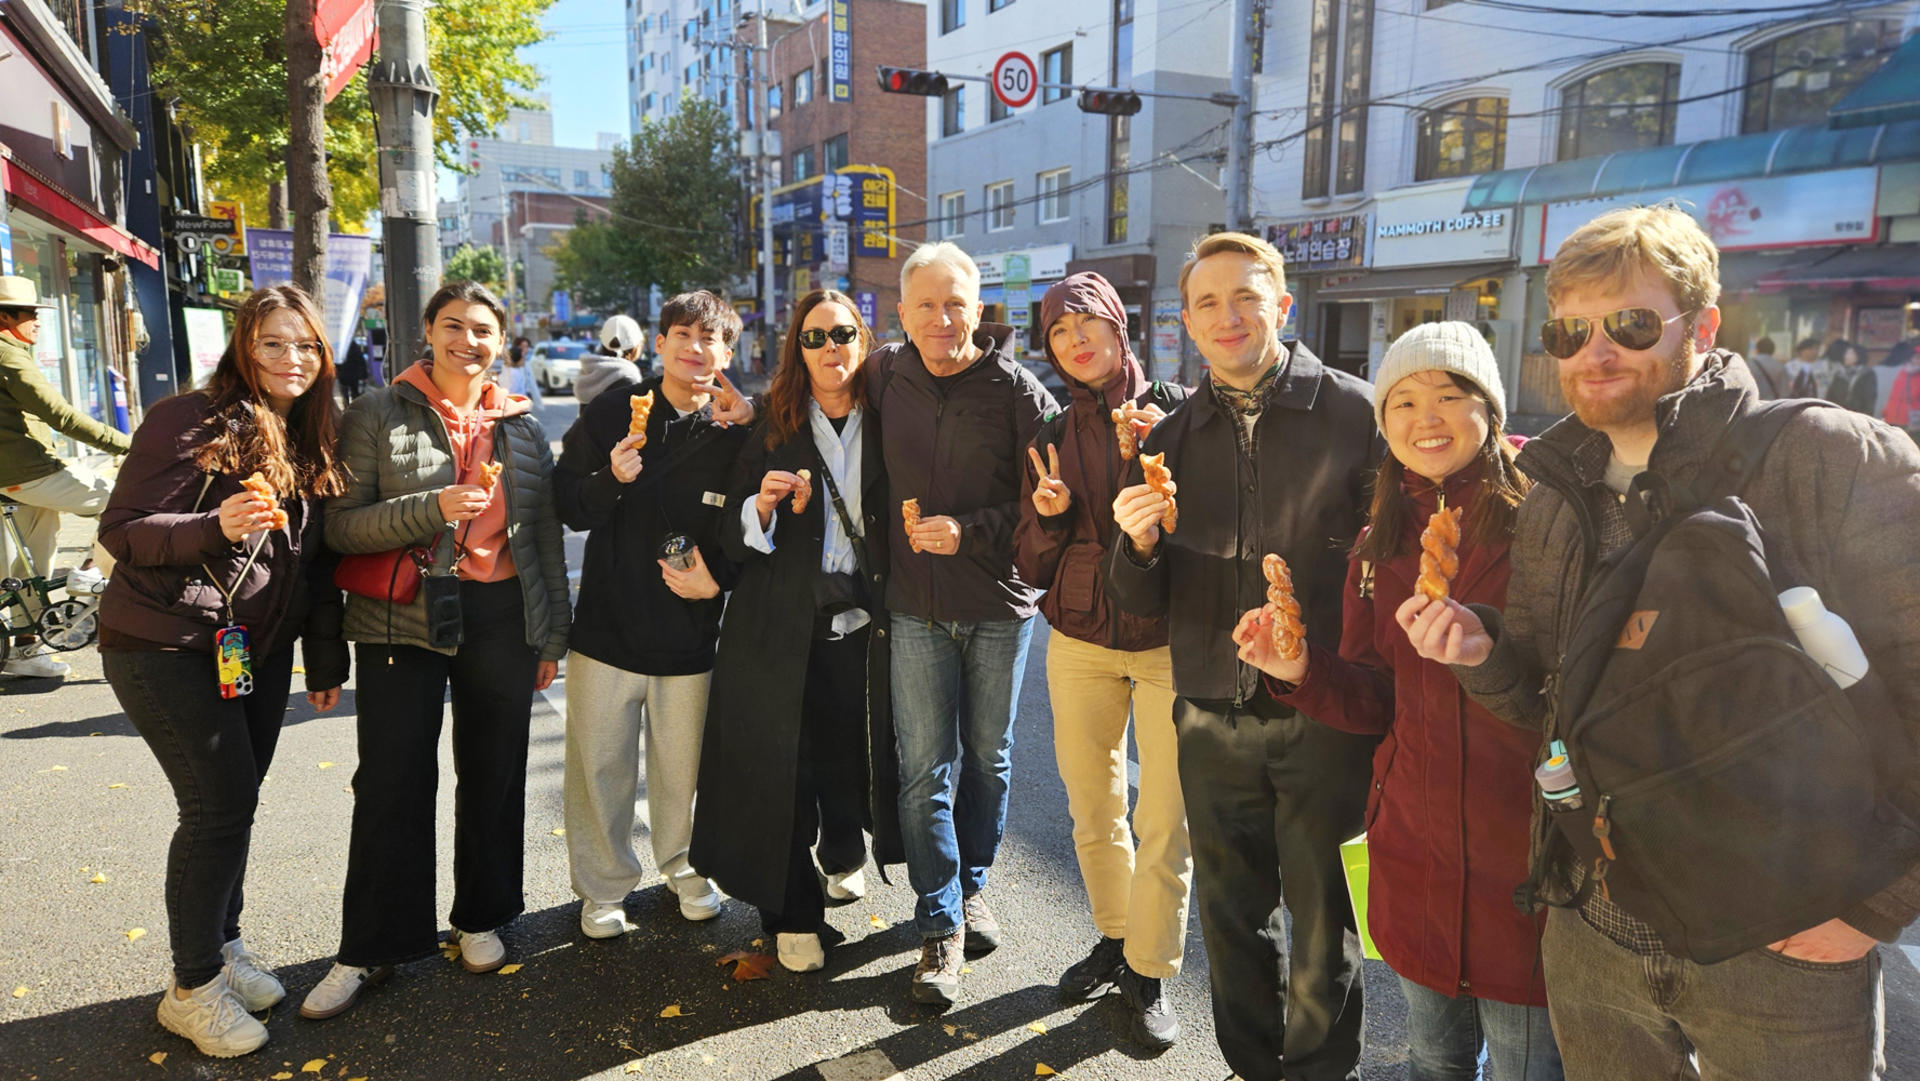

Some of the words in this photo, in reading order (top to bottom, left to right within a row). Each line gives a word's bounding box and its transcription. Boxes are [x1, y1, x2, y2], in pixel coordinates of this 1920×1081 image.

[1003, 67, 1028, 92] 50
[175, 220, 232, 229] NewFace
[1377, 220, 1442, 237] MAMMOTH
[1446, 213, 1501, 231] COFFEE
[1283, 237, 1351, 263] 노래연습장
